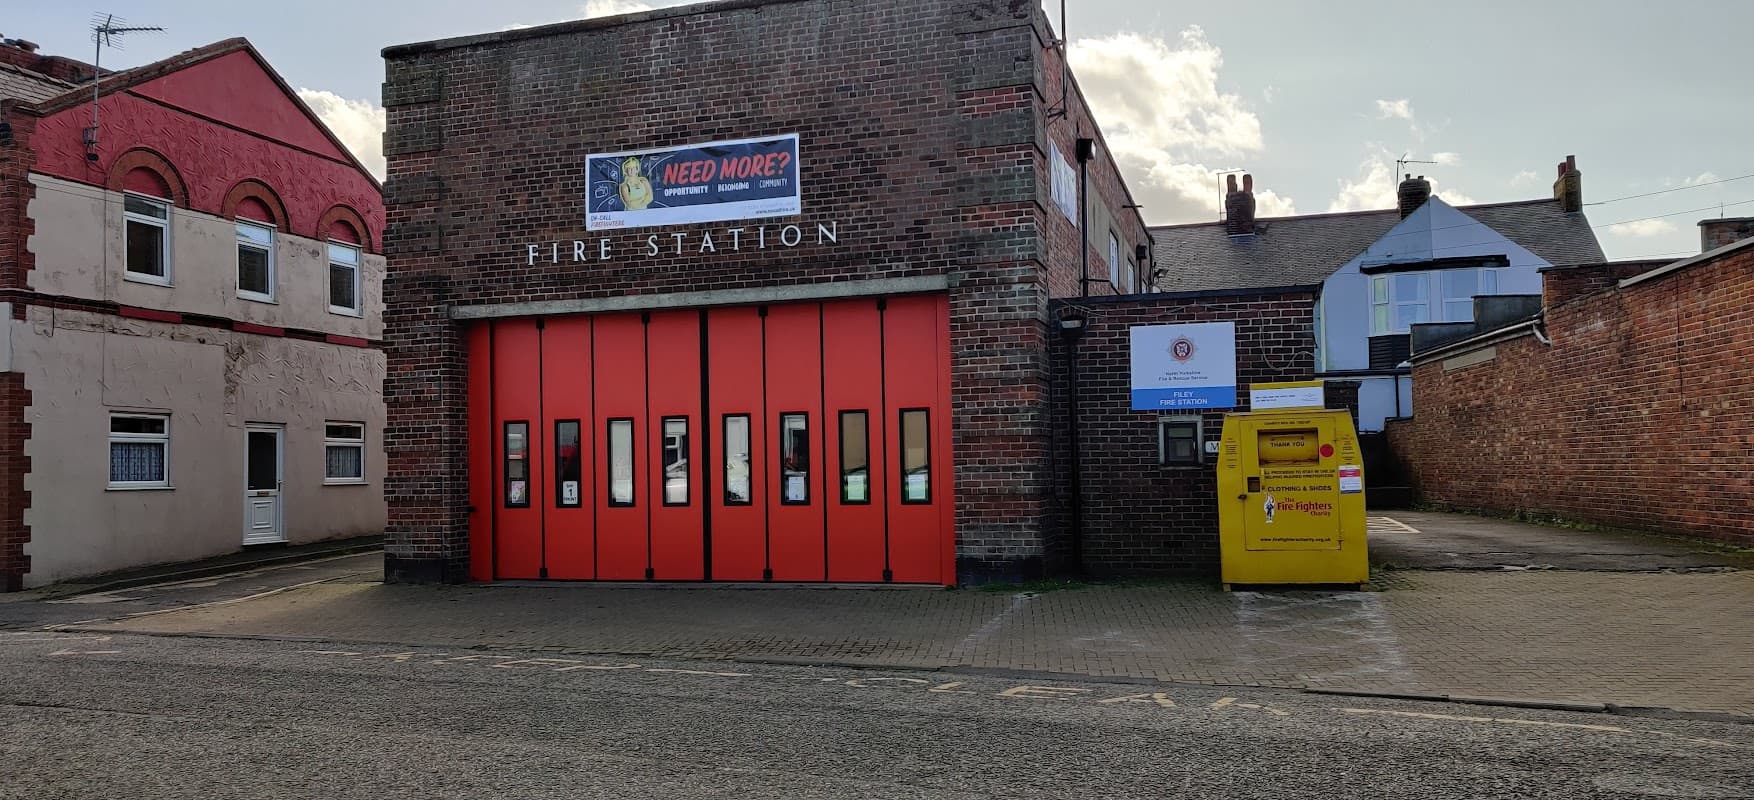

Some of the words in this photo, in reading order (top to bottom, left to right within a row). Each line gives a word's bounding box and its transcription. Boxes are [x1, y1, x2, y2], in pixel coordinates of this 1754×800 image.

[663, 159, 716, 185] NEED
[719, 151, 791, 180] MORE?
[664, 185, 708, 197] OPPORTUNITY
[759, 178, 788, 189] COMMUNITY
[527, 238, 612, 266] FIRE
[647, 221, 838, 257] STATION
[1277, 502, 1294, 511] Fire
[1295, 501, 1332, 512] Fighters
